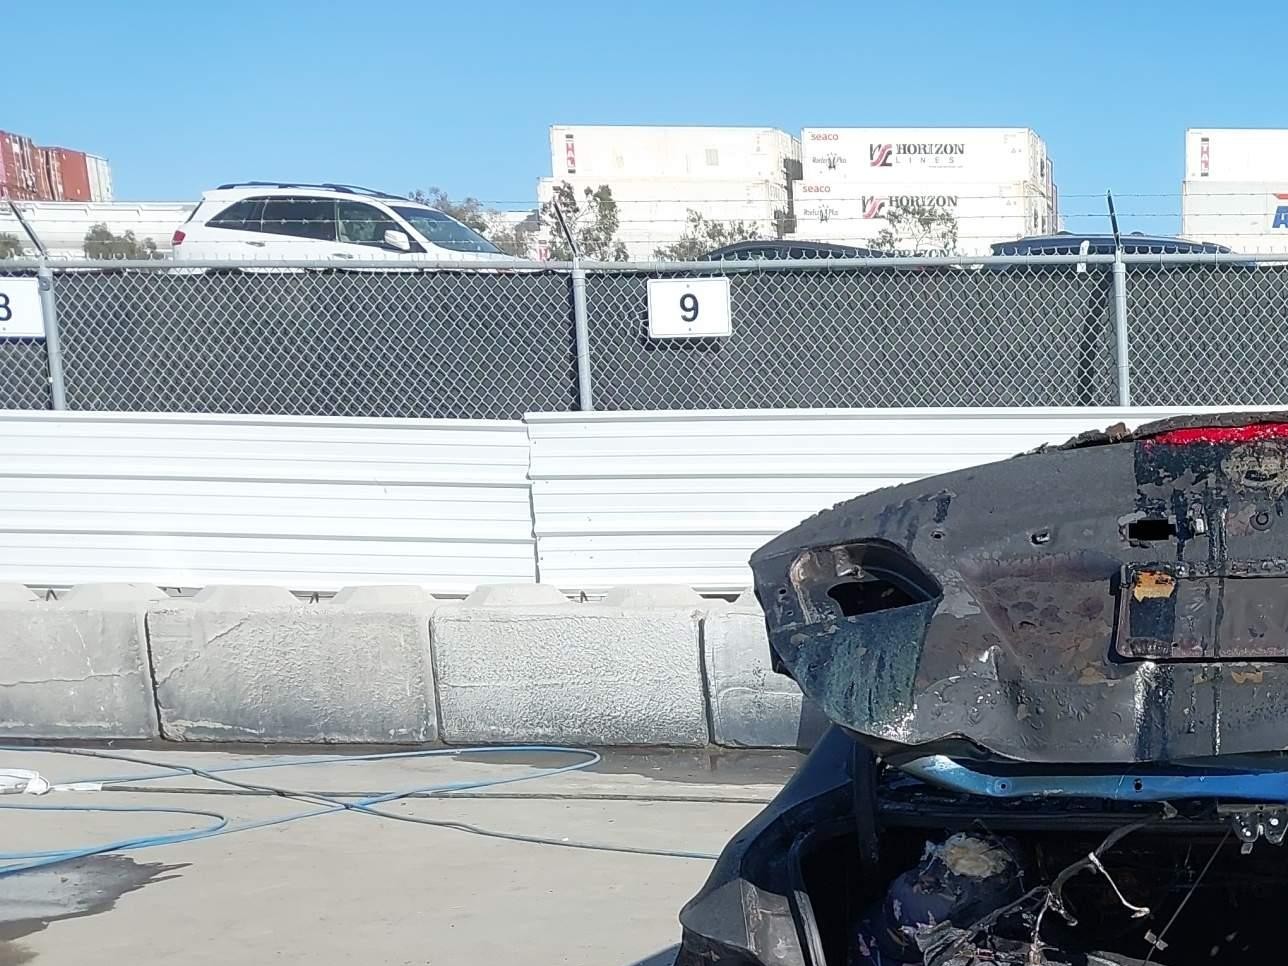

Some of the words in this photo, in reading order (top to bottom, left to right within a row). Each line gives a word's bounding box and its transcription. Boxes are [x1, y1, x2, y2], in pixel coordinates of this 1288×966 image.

[811, 133, 839, 141] seaco
[896, 143, 965, 155] HORIZON
[896, 156, 955, 164] LINES
[802, 185, 831, 193] seaco
[888, 195, 959, 207] HORIZON
[0, 293, 12, 322] 8
[680, 293, 699, 322] 9
